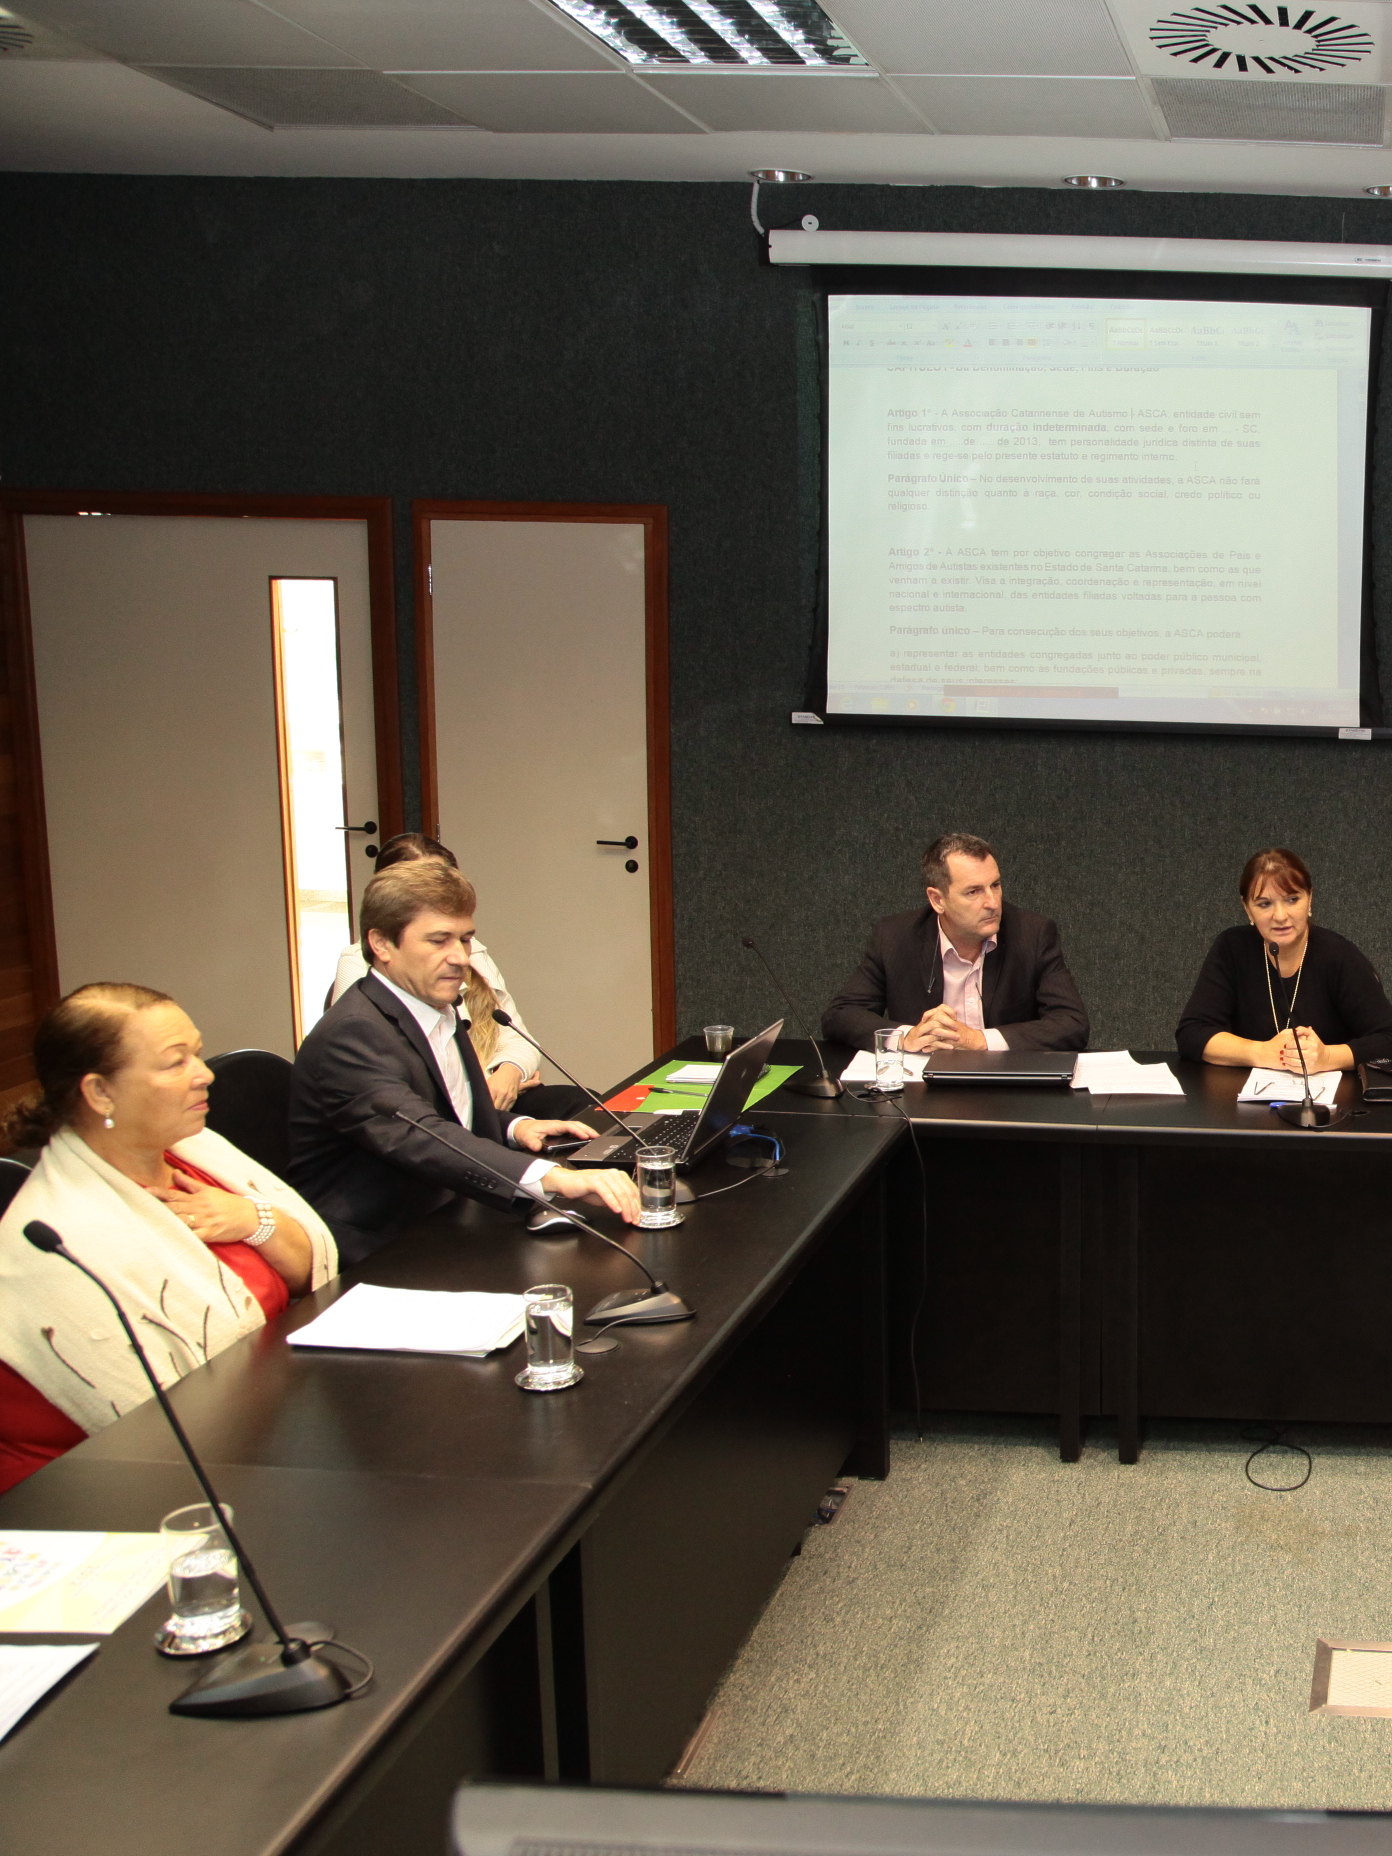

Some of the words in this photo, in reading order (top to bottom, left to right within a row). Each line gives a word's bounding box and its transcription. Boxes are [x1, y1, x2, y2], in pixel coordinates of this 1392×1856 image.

[887, 408, 918, 418] Artigo
[951, 408, 1008, 419] Associação
[1011, 408, 1069, 418] Catarinense
[1073, 409, 1085, 418] de
[1089, 409, 1128, 418] Autismo
[1137, 409, 1169, 419] ASCA,
[1173, 410, 1215, 418] entidade
[1218, 410, 1237, 418] civil
[887, 423, 904, 431] fins
[908, 423, 958, 432] lucrativos,
[986, 423, 1028, 434] duração
[1033, 423, 1108, 433] indeterminada,
[1139, 424, 1163, 432] sede
[1179, 424, 1198, 432] foro
[887, 436, 927, 445] fundada
[963, 437, 976, 446] de
[998, 437, 1009, 446] de
[1048, 438, 1067, 446] tem
[1070, 437, 1139, 449] personalidade
[1143, 438, 1178, 449] jurídica
[1182, 438, 1217, 447] distinta
[1220, 438, 1233, 447] de
[888, 451, 921, 459] filiadas
[933, 453, 969, 462] rege-se
[972, 451, 992, 462] pelo
[995, 451, 1037, 462] presente
[1040, 451, 1079, 460] estatuto
[1091, 452, 1139, 462] regimento
[1142, 452, 1176, 461] interno.
[888, 474, 937, 484] Parágrafo
[939, 472, 968, 483] Único
[979, 474, 993, 483] No
[996, 474, 1078, 484] desenvolvimento
[1080, 475, 1093, 484] de
[1122, 475, 1174, 485] atividades,
[1186, 476, 1216, 484] ASCA
[1219, 476, 1238, 485] não
[888, 488, 930, 499] qualquer
[936, 488, 978, 499] distinção
[984, 488, 1018, 499] quanto
[1035, 491, 1058, 500] raça,
[1088, 489, 1132, 500] condição
[1138, 490, 1168, 499] social,
[1175, 490, 1202, 499] credo
[1208, 490, 1243, 501] político
[888, 547, 920, 558] Artigo
[957, 548, 987, 556] ASCA
[991, 548, 1009, 557] tem
[1013, 550, 1029, 559] por
[1033, 548, 1071, 559] objetivo
[1075, 551, 1126, 560] congregar
[1145, 550, 1208, 561] Associações
[1212, 550, 1224, 559] de
[1230, 551, 1251, 559] Pais
[889, 561, 924, 572] Amigos
[926, 562, 938, 570] de
[940, 562, 978, 570] Autistas
[980, 562, 1029, 571] existentes
[1045, 563, 1078, 572] Estado
[1080, 563, 1092, 572] de
[1096, 563, 1124, 572] Santa
[1127, 563, 1169, 573] Catarina,
[1174, 564, 1195, 573] bem
[1243, 567, 1261, 575] que
[889, 575, 927, 584] venham
[975, 576, 996, 585] Visa
[1009, 576, 1061, 587] integração,
[1066, 577, 1130, 588] coordenação
[1143, 578, 1215, 589] representação,
[889, 589, 929, 598] nacional
[943, 590, 1006, 600] internacional,
[1010, 590, 1028, 599] das
[1032, 591, 1079, 600] entidades
[1083, 591, 1117, 600] filiadas
[1122, 592, 1162, 601] voltadas
[1166, 594, 1188, 603] para
[1201, 594, 1237, 604] pessoa
[889, 603, 930, 614] espectro
[933, 603, 969, 612] autista.
[890, 625, 939, 636] Parágrafo
[942, 626, 970, 635] único
[982, 626, 1005, 635] Para
[1007, 627, 1067, 638] consecução
[1069, 628, 1087, 636] dos
[1174, 629, 1204, 638] ASCA
[904, 648, 958, 659] representar
[978, 649, 1025, 658] entidades
[1030, 650, 1093, 661] congregadas
[1098, 651, 1121, 661] junto
[1141, 651, 1170, 662] poder
[1174, 652, 1209, 662] público
[890, 662, 931, 671] estadual
[984, 663, 1005, 672] bem
[1038, 664, 1050, 672] às
[1053, 664, 1104, 675] fundações
[1108, 665, 1148, 676] públicas
[1209, 668, 1245, 677] sempre
